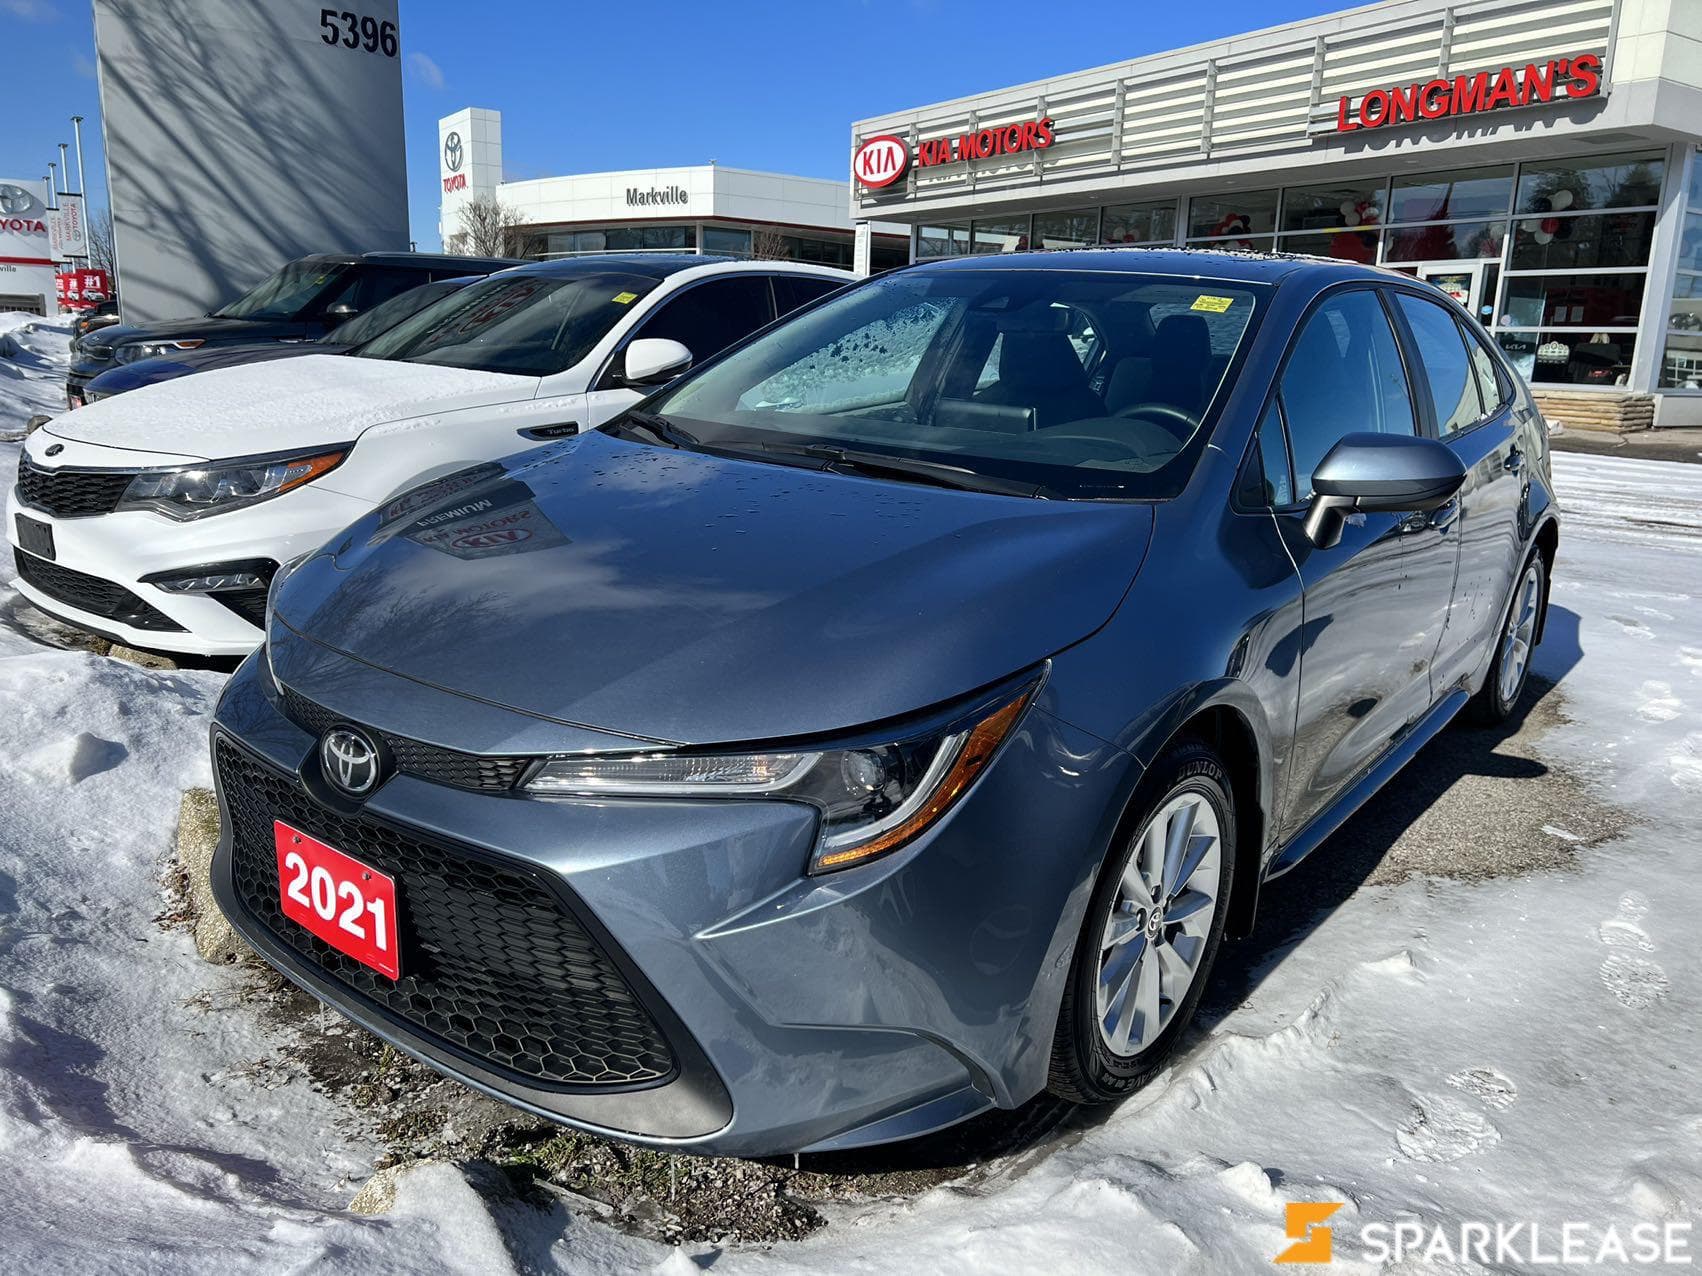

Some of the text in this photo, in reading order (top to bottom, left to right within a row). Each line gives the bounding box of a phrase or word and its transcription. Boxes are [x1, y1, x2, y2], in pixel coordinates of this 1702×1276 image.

[320, 8, 397, 57] 5396
[1337, 54, 1600, 132] LONGMAN'S
[918, 117, 1055, 168] KIA MOTORS
[862, 148, 897, 176] KIA
[443, 173, 467, 194] TOYOTA
[626, 185, 689, 206] Markville
[547, 427, 575, 435] Turbo
[1177, 760, 1223, 782] DUNLOP
[285, 852, 387, 951] 2021
